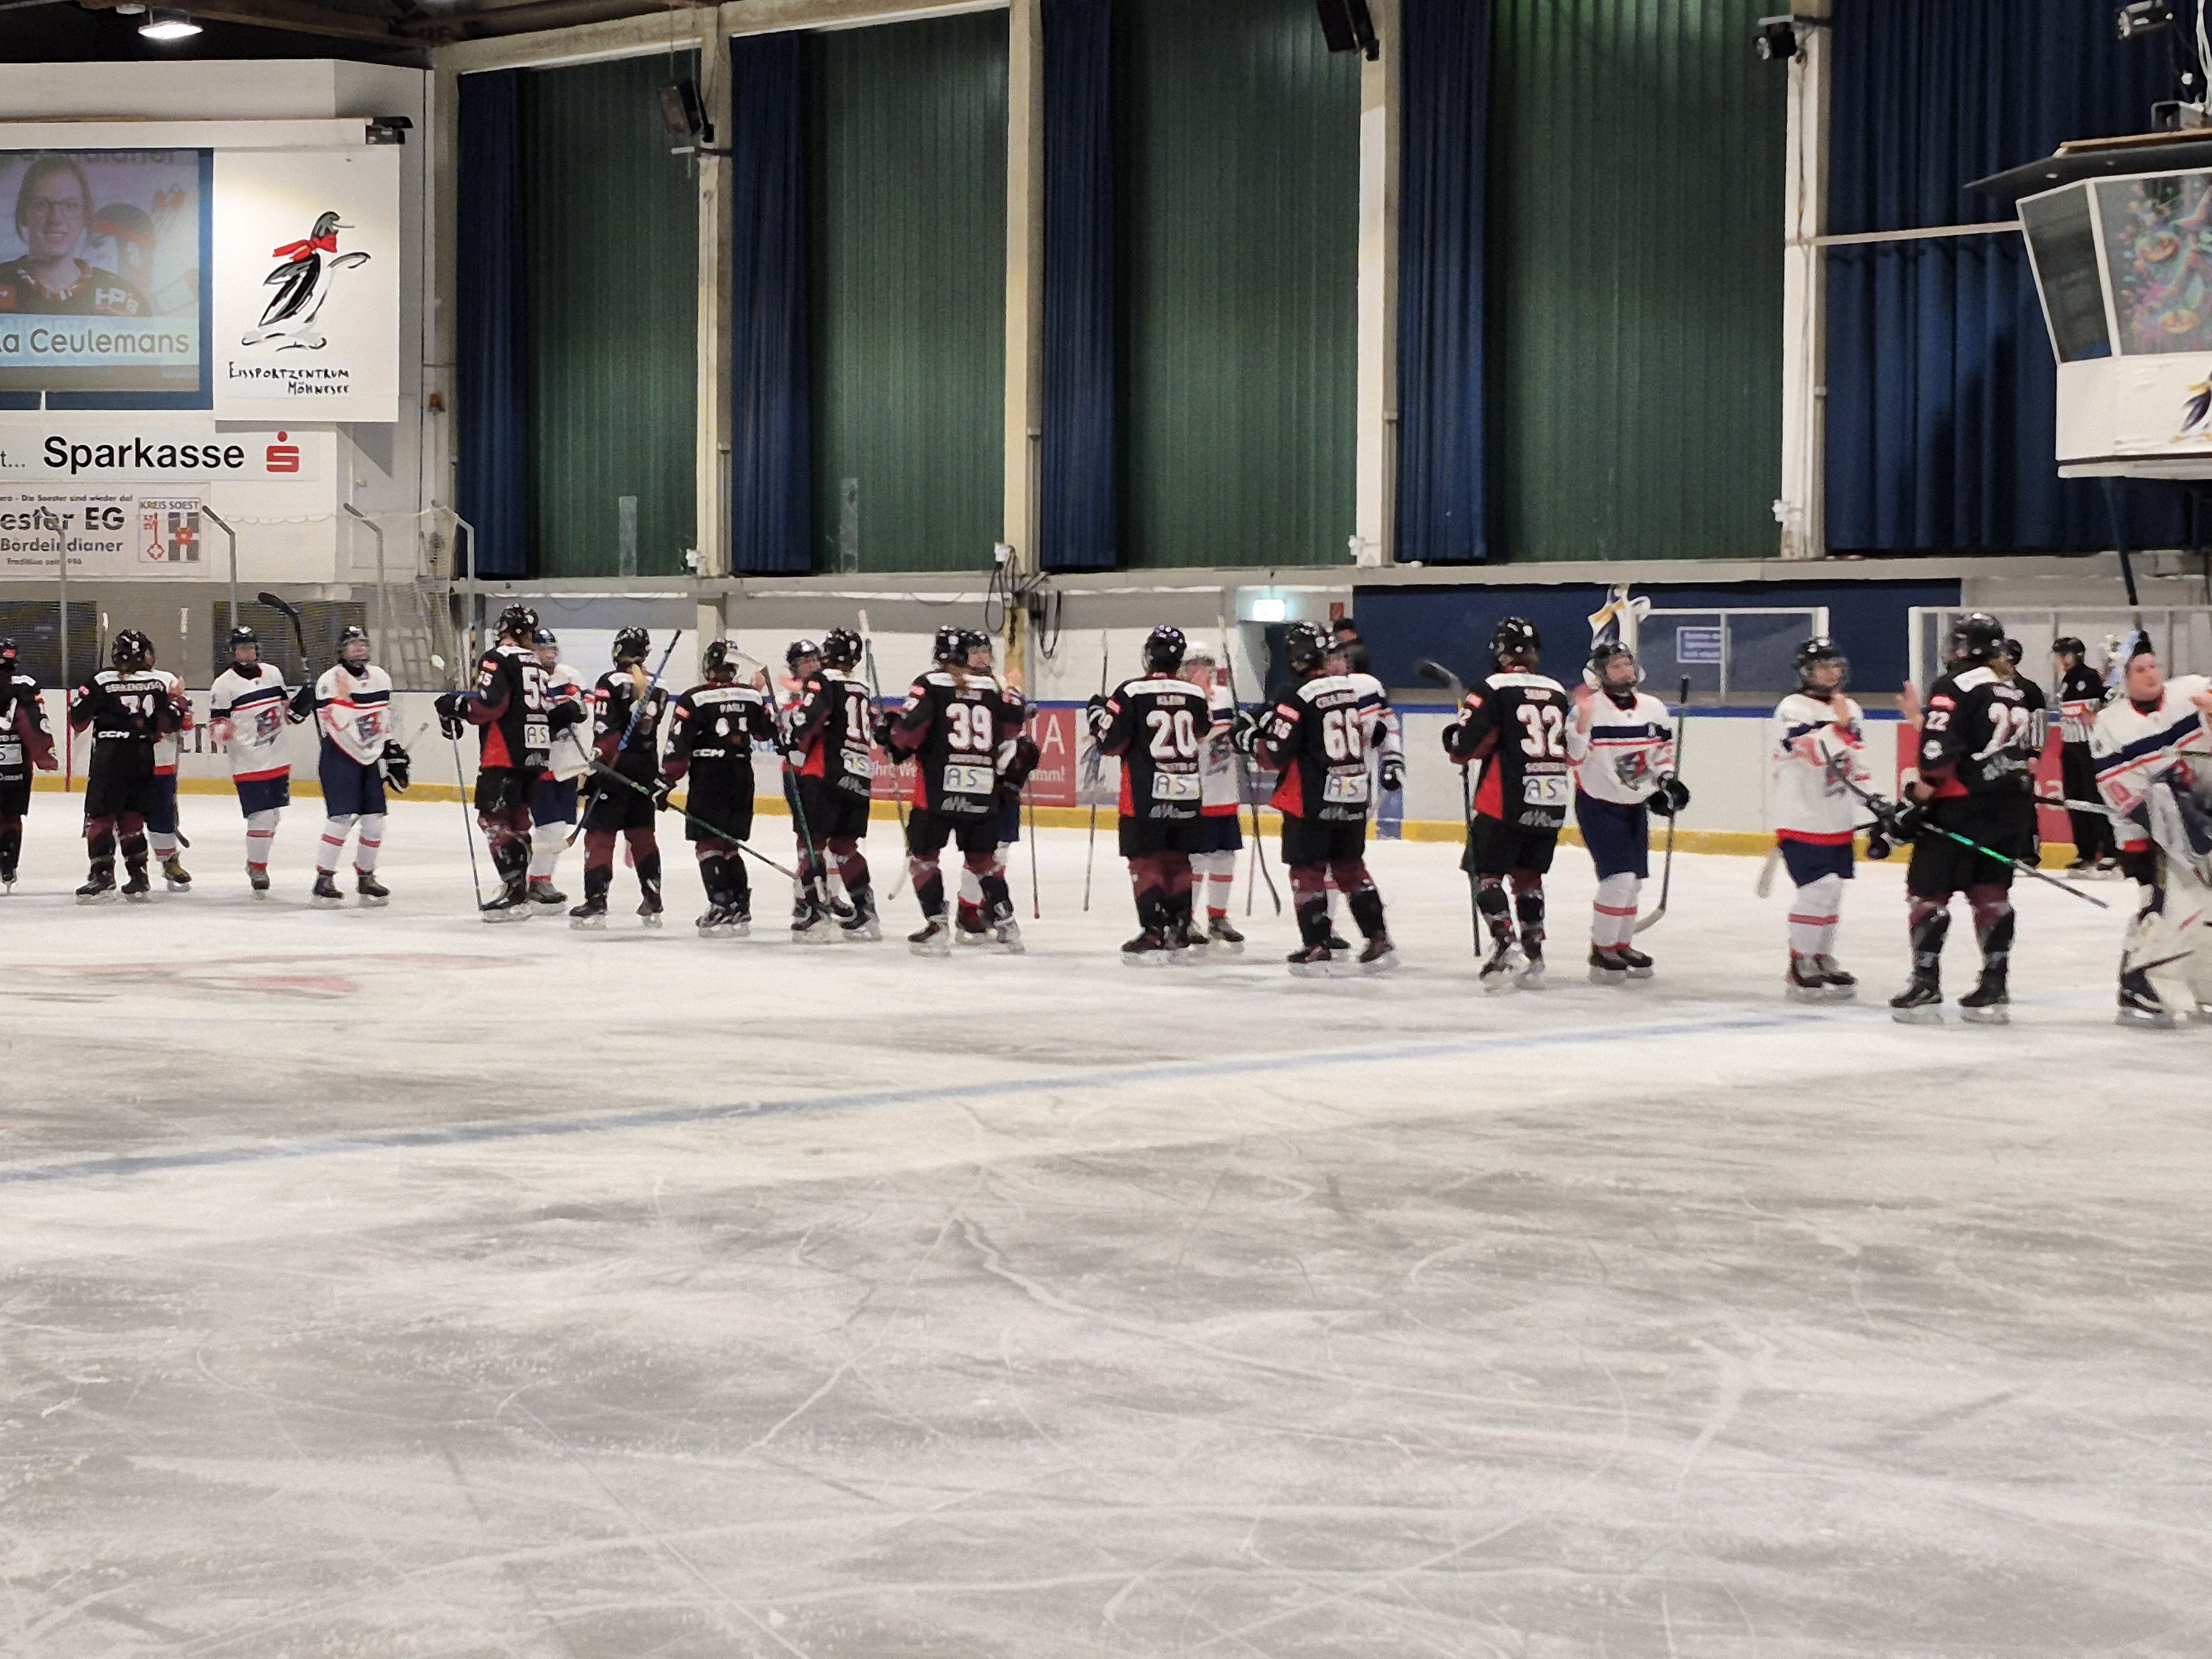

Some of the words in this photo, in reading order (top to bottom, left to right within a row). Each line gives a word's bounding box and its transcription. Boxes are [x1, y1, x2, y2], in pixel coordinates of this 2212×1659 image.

[30, 328, 190, 353] Ceulemans
[43, 436, 244, 474] Sparkasse
[85, 507, 125, 530] EG
[169, 501, 199, 509] SOEST
[97, 731, 131, 739] CCM
[946, 702, 993, 752] 39
[1146, 710, 1199, 759] 20
[1516, 703, 1565, 758] 32
